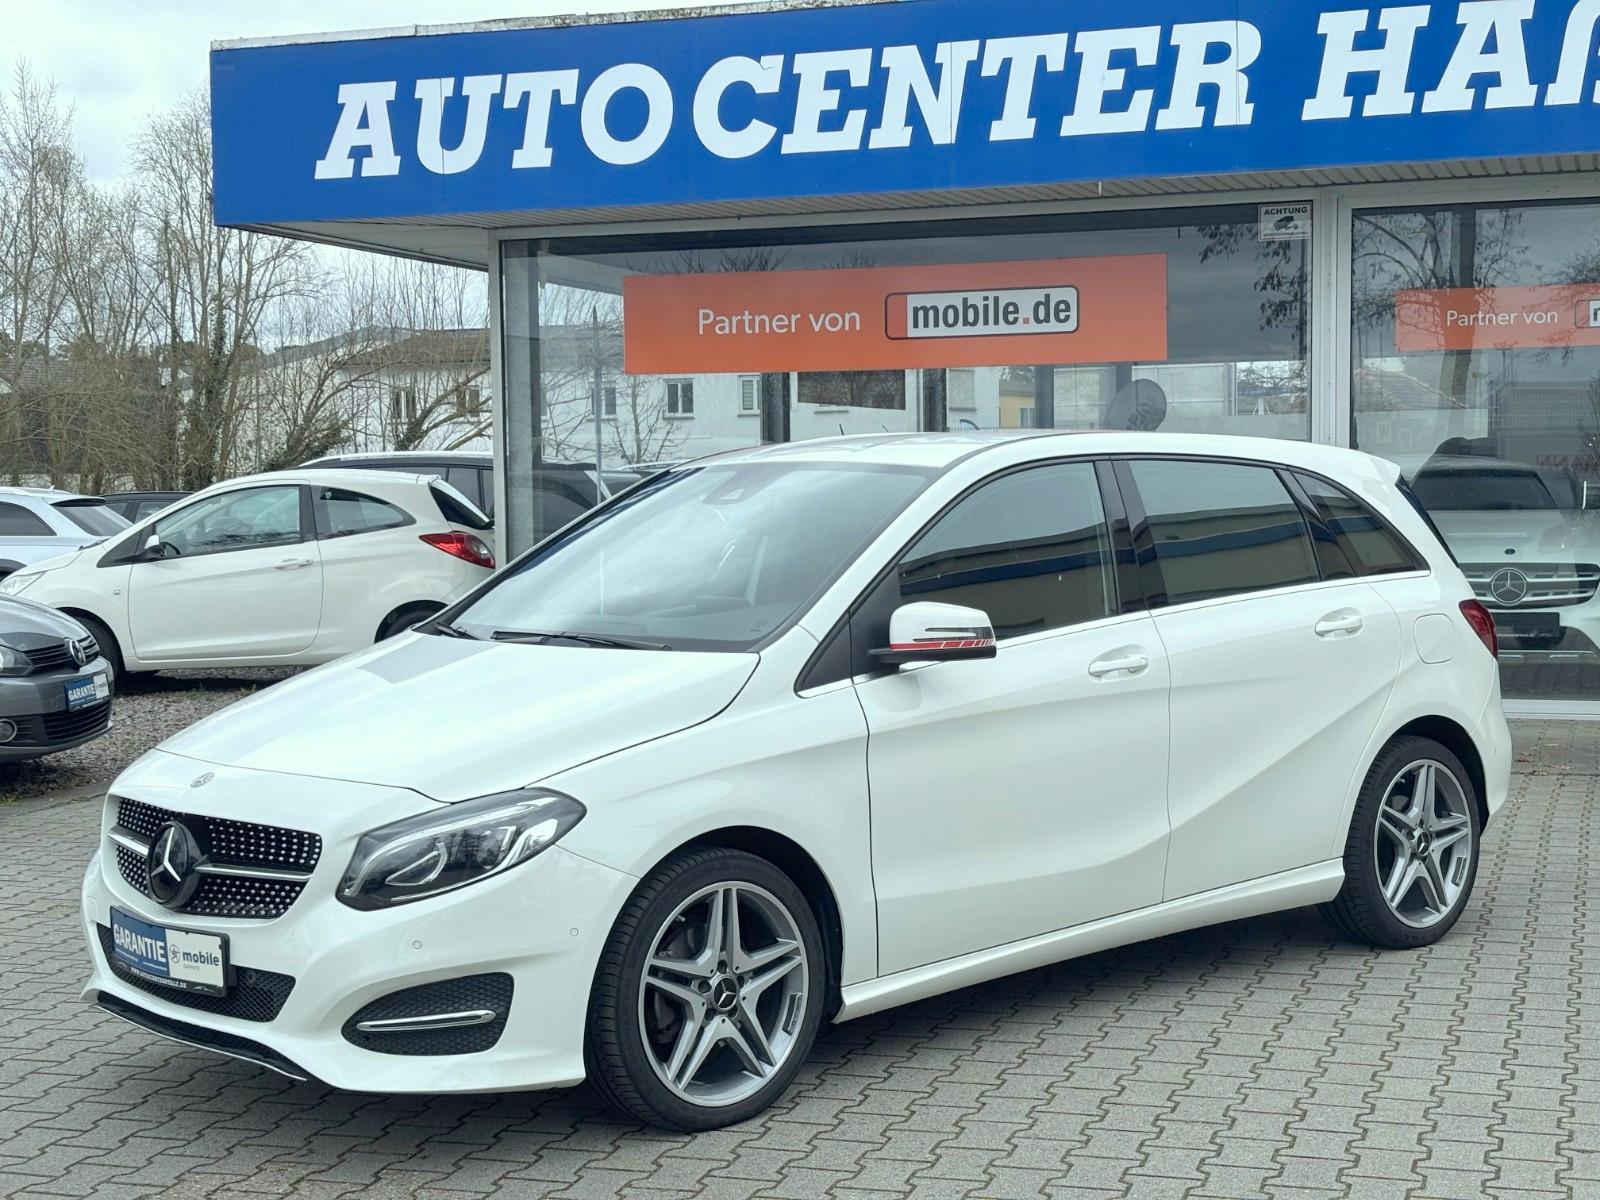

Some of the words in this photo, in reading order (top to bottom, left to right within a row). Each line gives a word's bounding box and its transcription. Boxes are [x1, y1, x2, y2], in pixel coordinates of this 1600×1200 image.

[1263, 206, 1308, 216] ACHTUNG
[698, 308, 801, 336] Partner
[808, 311, 861, 333] von
[912, 293, 1072, 329] mobile.de
[1446, 309, 1518, 327] Partner
[1522, 310, 1559, 325] von
[68, 684, 96, 701] GARANTIE
[113, 923, 167, 963] GARANTIE
[182, 950, 220, 967] mobile
